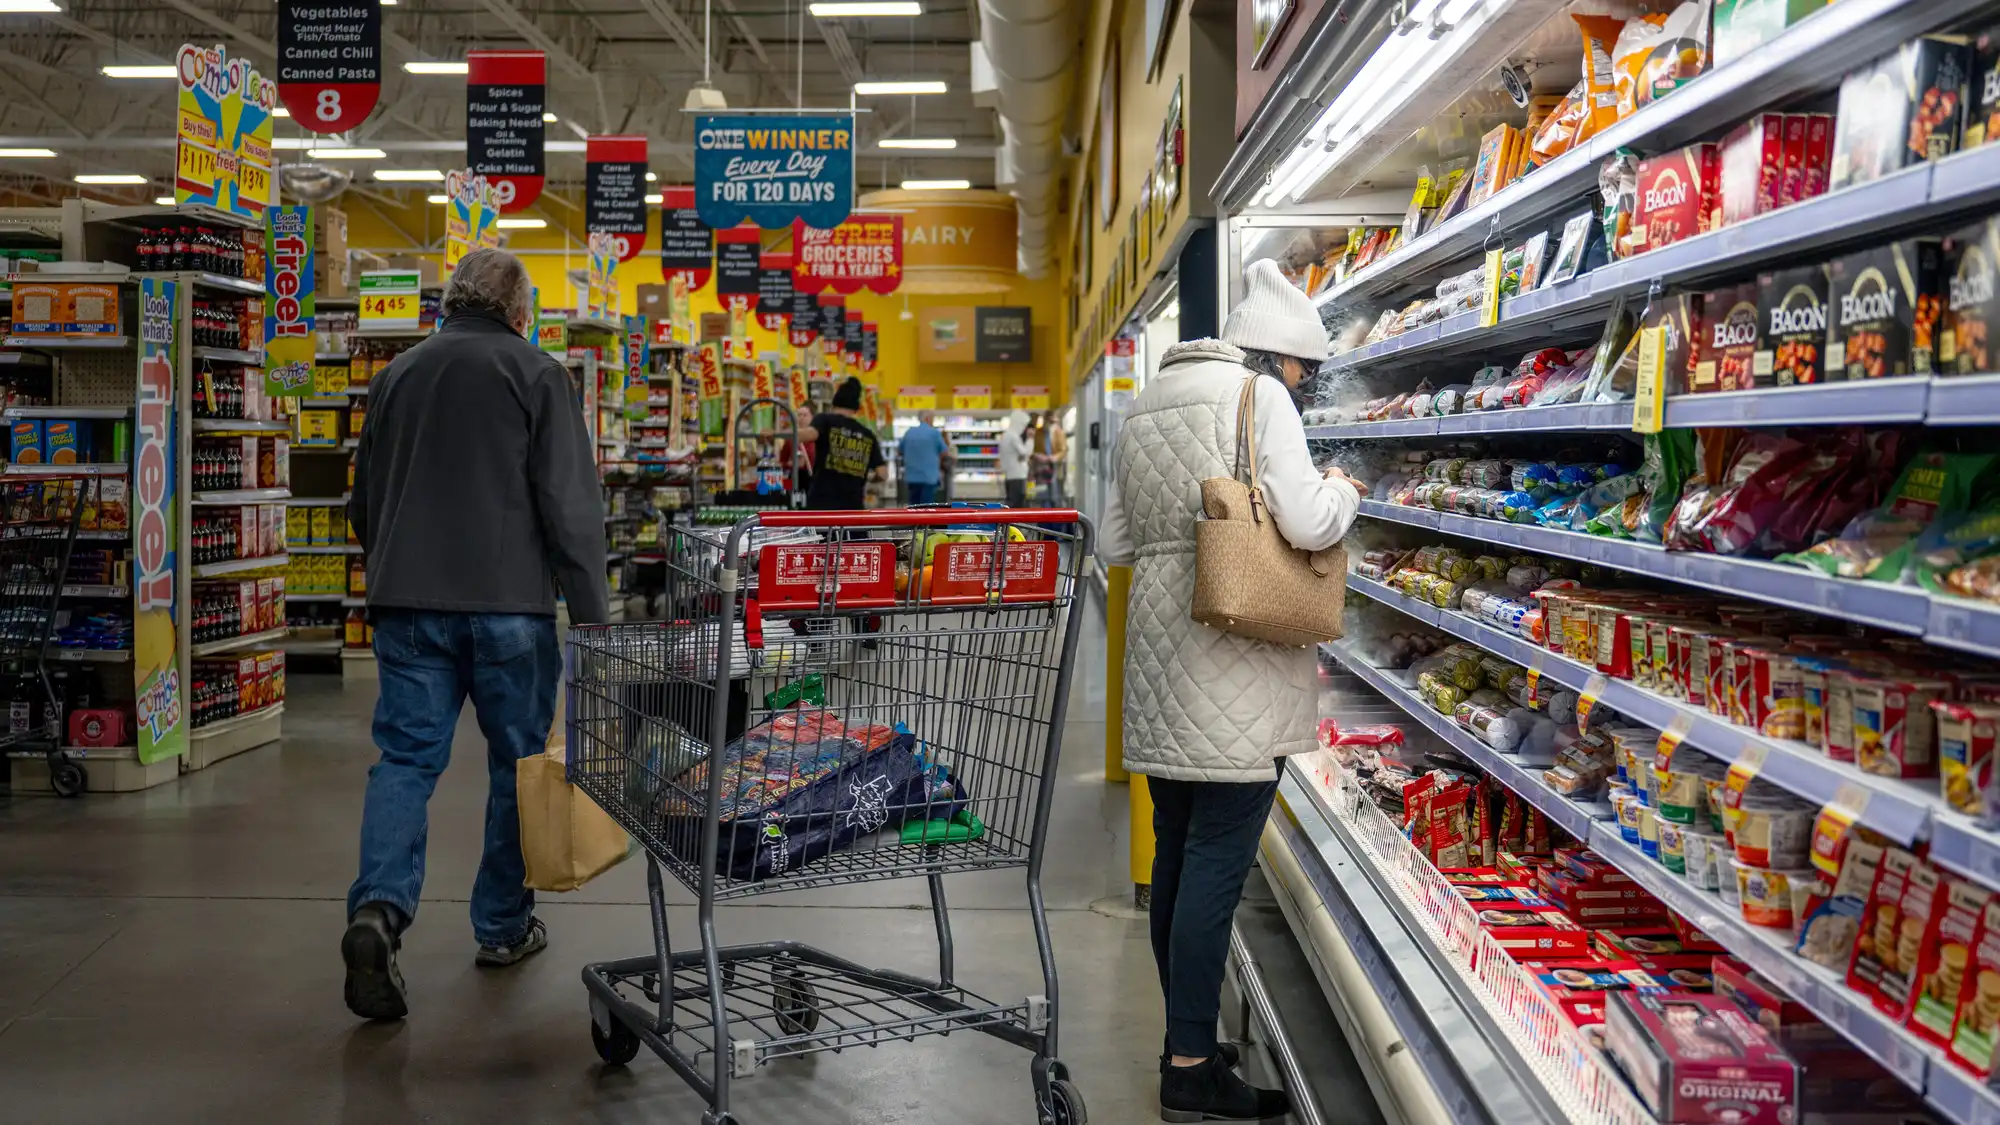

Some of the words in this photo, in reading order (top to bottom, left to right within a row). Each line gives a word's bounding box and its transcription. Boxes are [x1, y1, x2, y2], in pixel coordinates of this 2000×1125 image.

[291, 7, 368, 20] Vegetables
[294, 24, 332, 33] Canned
[334, 24, 364, 33] Meat/
[297, 33, 361, 42] Fish/Tomato
[285, 47, 338, 58] Canned
[342, 47, 374, 58] Chili
[180, 48, 240, 98] Combo
[242, 63, 276, 110] Loco
[282, 68, 334, 79] Canned
[338, 68, 376, 79] Pasta
[488, 88, 523, 98] Spices
[316, 89, 342, 122] 8
[470, 102, 498, 112] Flour
[500, 103, 508, 112] &
[510, 102, 542, 114] Sugar
[183, 118, 197, 136] Buy
[197, 122, 212, 139] this!
[470, 118, 506, 130] Baking
[509, 118, 542, 128] Needs
[244, 140, 254, 153] You
[484, 138, 527, 146] Shortening
[700, 129, 745, 150] ONE
[746, 129, 850, 150] WINNER
[216, 154, 238, 172] free!
[486, 148, 525, 158] Gelatin
[476, 163, 503, 173] Cake
[506, 163, 536, 173] Mixes
[602, 164, 630, 172] Cereal
[724, 156, 781, 180] Every
[786, 151, 828, 179] Day
[495, 180, 516, 205] 9
[713, 182, 748, 202] FOR
[753, 182, 784, 202] 120
[789, 182, 835, 202] DAYS
[1644, 182, 1688, 213] BACON
[276, 212, 300, 222] Look
[598, 212, 634, 220] Pudding
[274, 224, 305, 232] what's
[588, 224, 621, 233] Canned
[623, 224, 643, 232] Fruit
[802, 226, 834, 242] Win
[832, 223, 894, 245] FREE
[802, 246, 894, 263] GROCERIES
[812, 264, 834, 276] FOR
[837, 264, 846, 276] A
[850, 264, 884, 276] YEAR!
[276, 236, 307, 336] free!
[1949, 268, 1994, 311] BACON
[144, 292, 169, 316] Look
[364, 296, 406, 316] $445
[1840, 288, 1897, 326] BACON
[1769, 304, 1828, 335] BACON
[142, 320, 173, 342] what's
[1712, 323, 1756, 348] BACO
[630, 332, 644, 388] free!
[270, 361, 310, 381] Combo
[139, 353, 174, 610] free!
[137, 671, 178, 727] Combo
[150, 700, 180, 742] Loco
[1680, 1083, 1786, 1102] ORIGINAL
